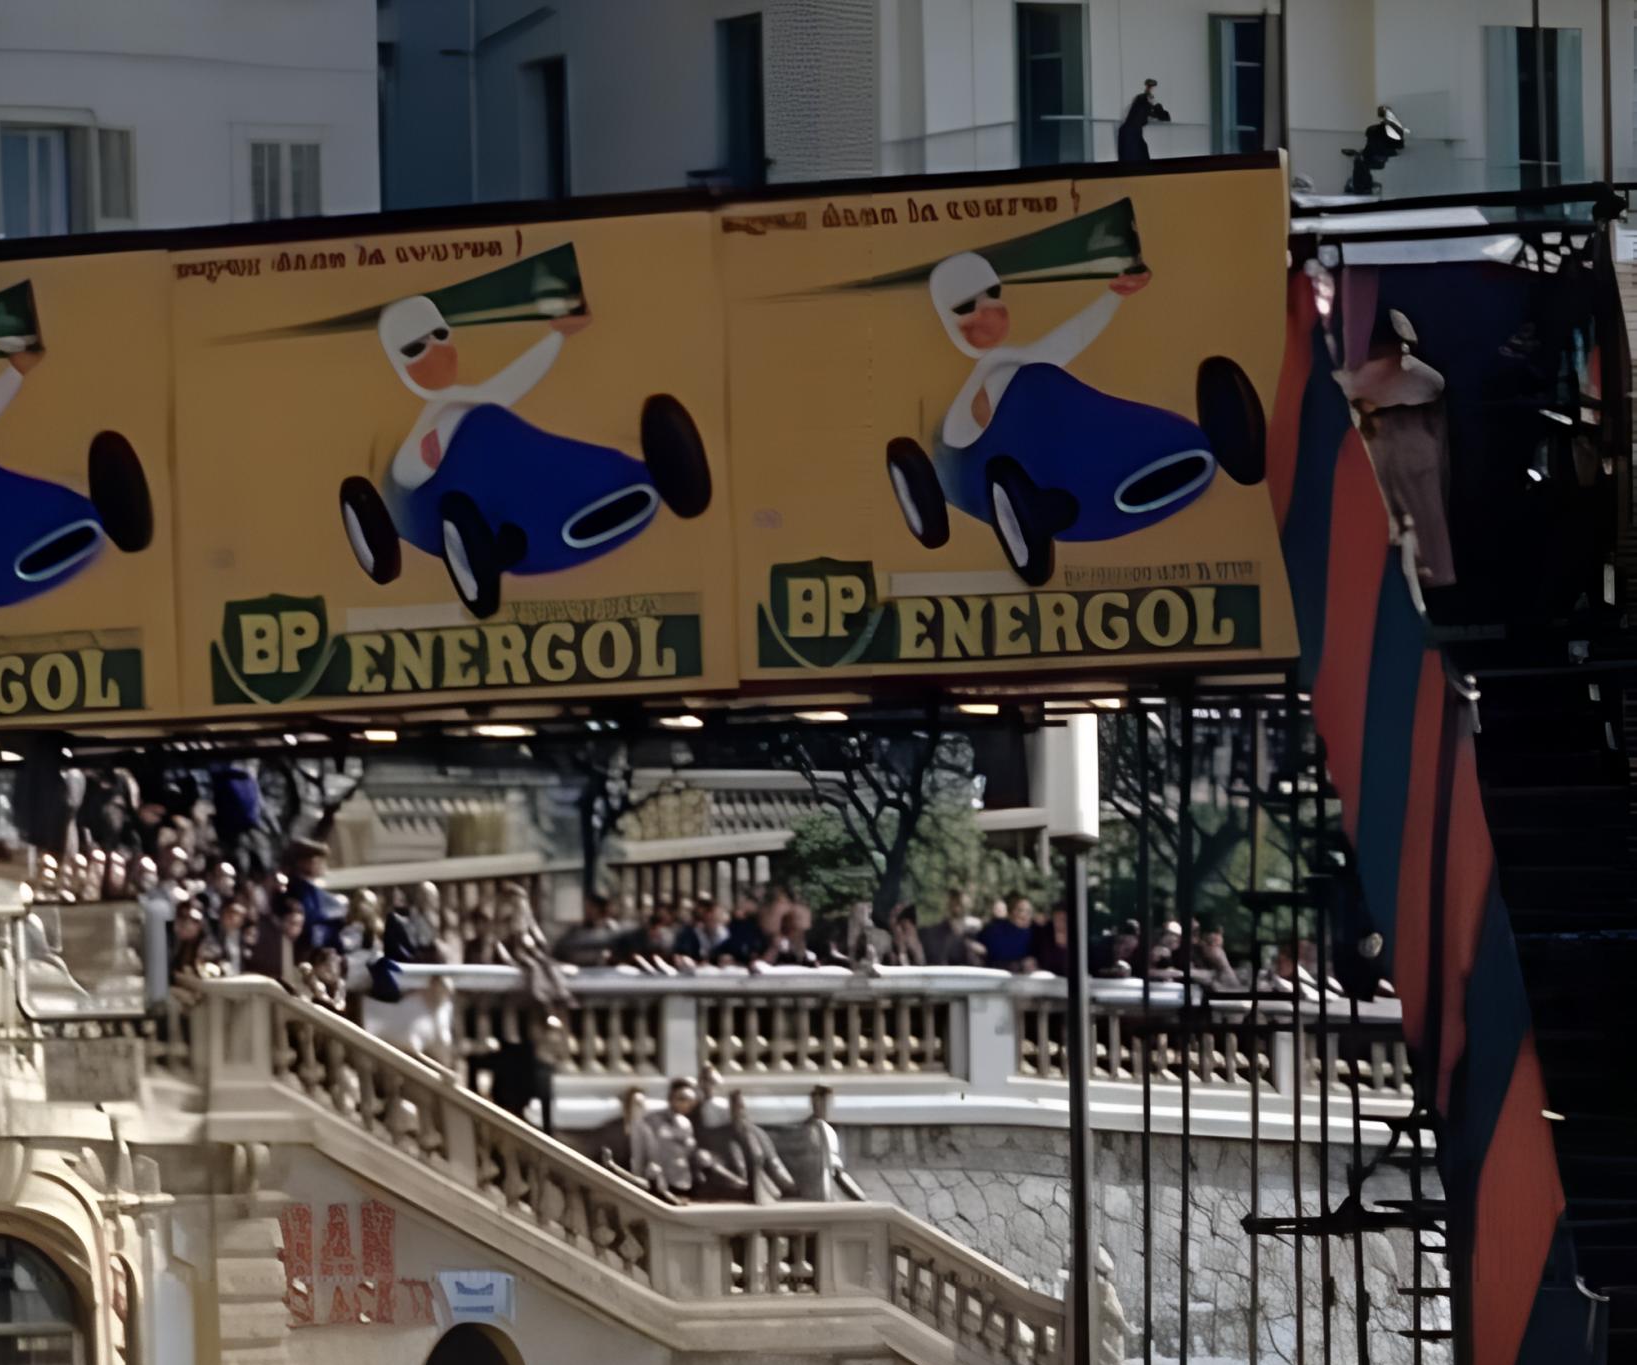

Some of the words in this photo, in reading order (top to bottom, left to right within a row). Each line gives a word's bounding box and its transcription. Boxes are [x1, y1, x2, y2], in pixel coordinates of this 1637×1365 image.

[239, 611, 320, 675] BP
[342, 616, 677, 693] ENERGOL
[786, 575, 866, 638] BP
[896, 587, 1235, 659] ENERGOL
